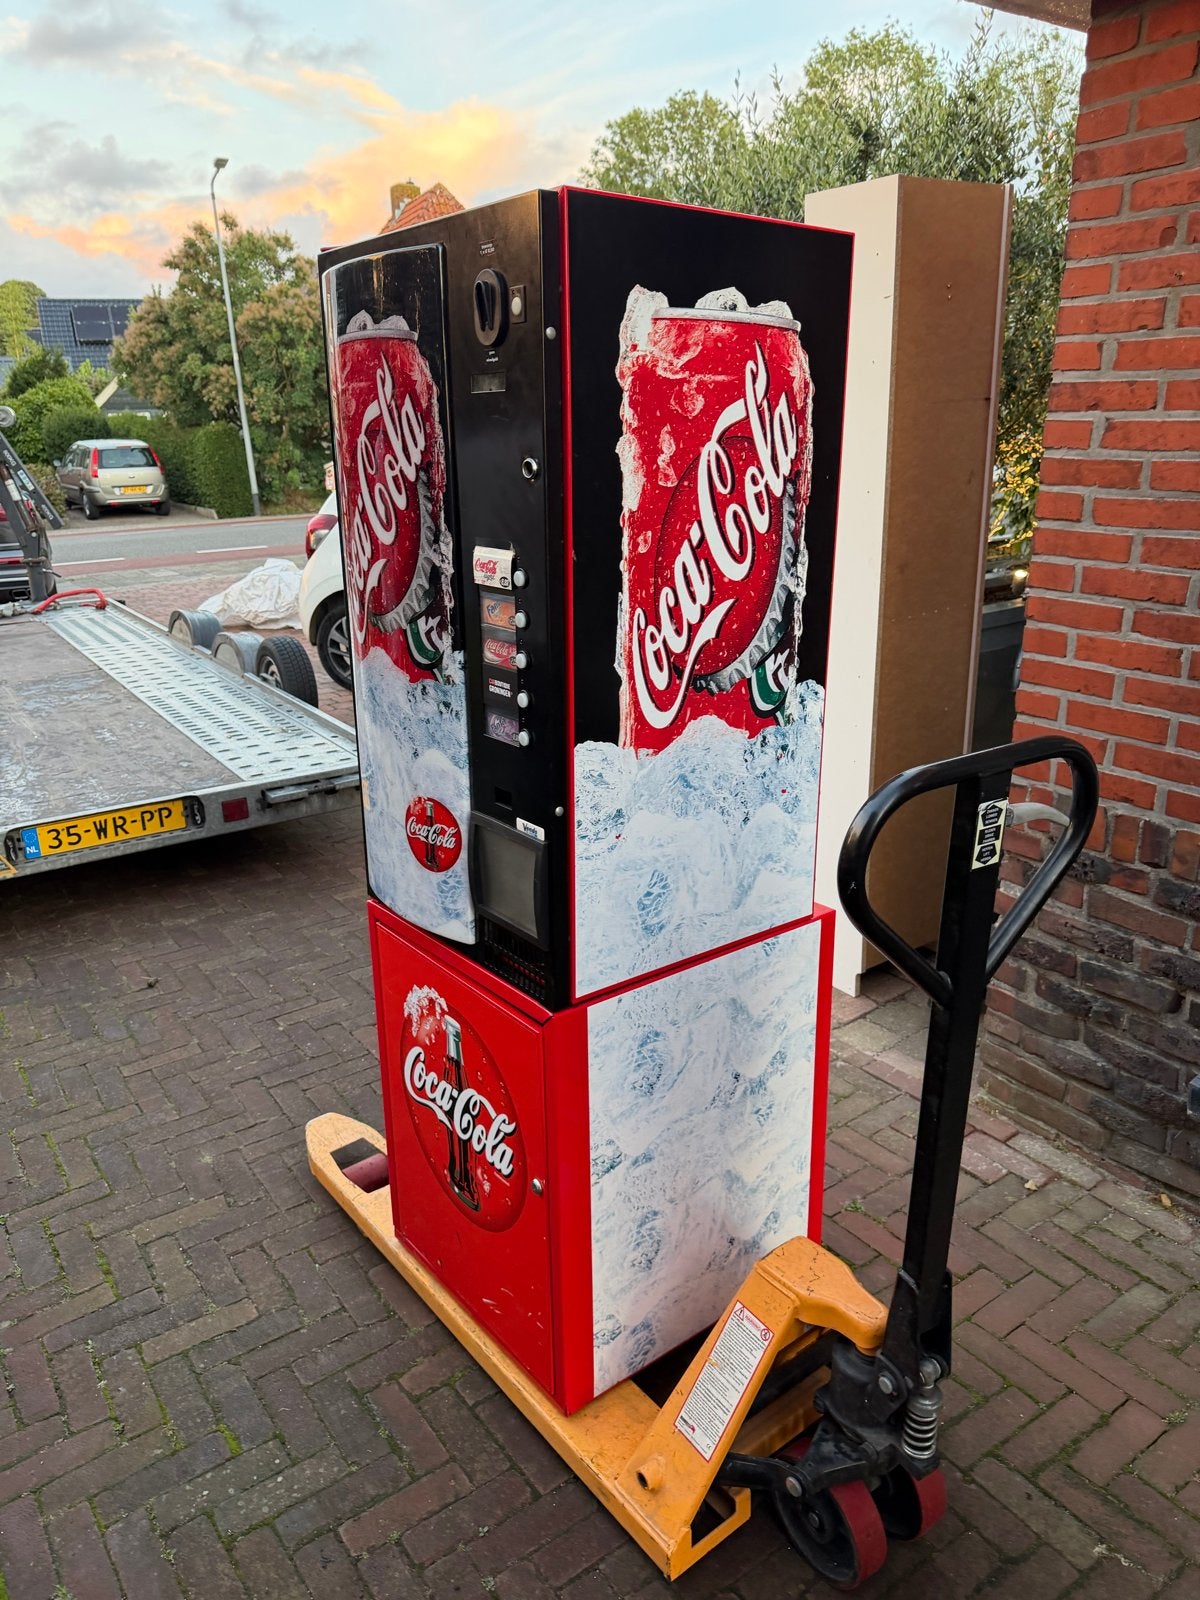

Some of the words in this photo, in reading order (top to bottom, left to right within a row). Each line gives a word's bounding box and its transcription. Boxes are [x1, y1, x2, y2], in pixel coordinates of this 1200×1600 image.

[632, 337, 798, 729] Coca-Cola
[26, 846, 38, 854] NL
[46, 806, 172, 850] 35-WR-PP
[407, 816, 458, 849] Coca-Cola
[404, 1046, 516, 1176] Coca-Cola
